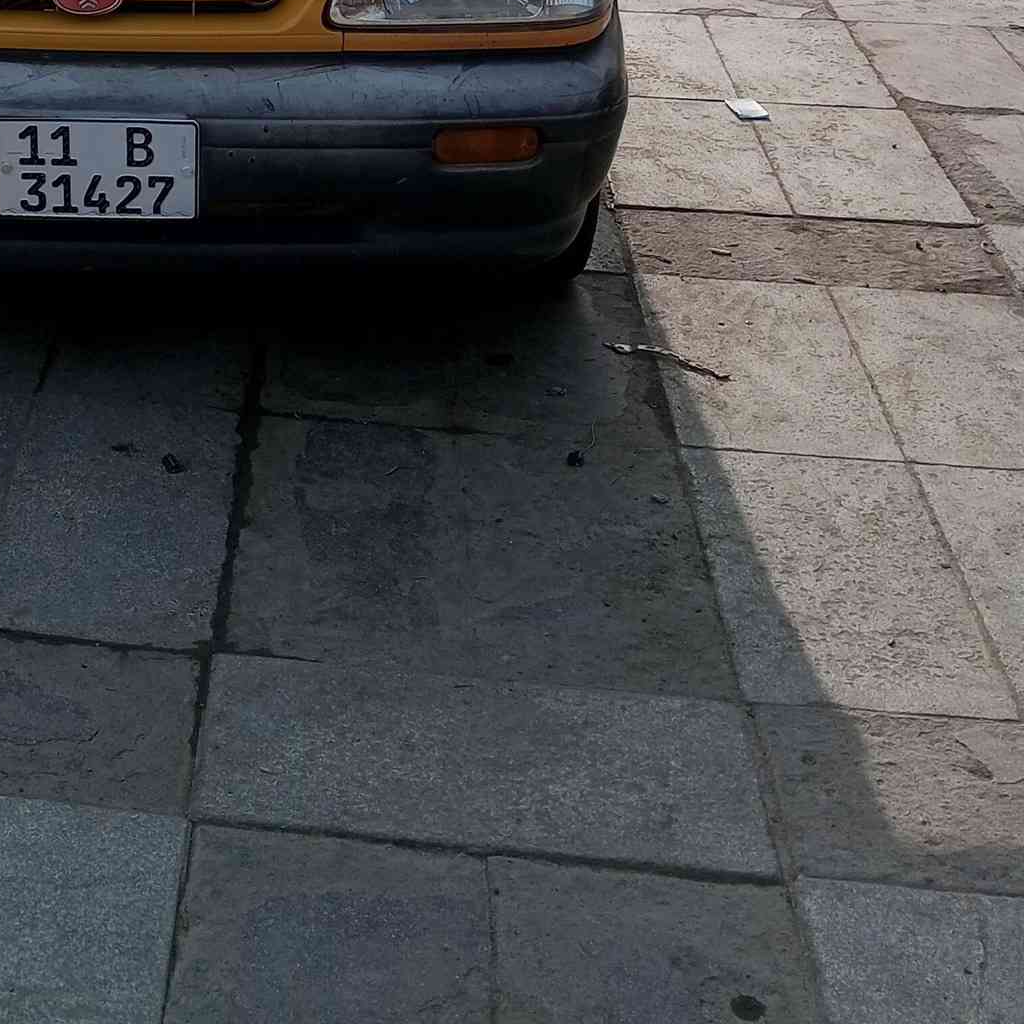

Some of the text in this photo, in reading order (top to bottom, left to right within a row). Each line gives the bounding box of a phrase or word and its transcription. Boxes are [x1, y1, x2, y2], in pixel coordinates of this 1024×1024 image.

[18, 125, 155, 168] 11 B
[19, 172, 175, 215] 31427
